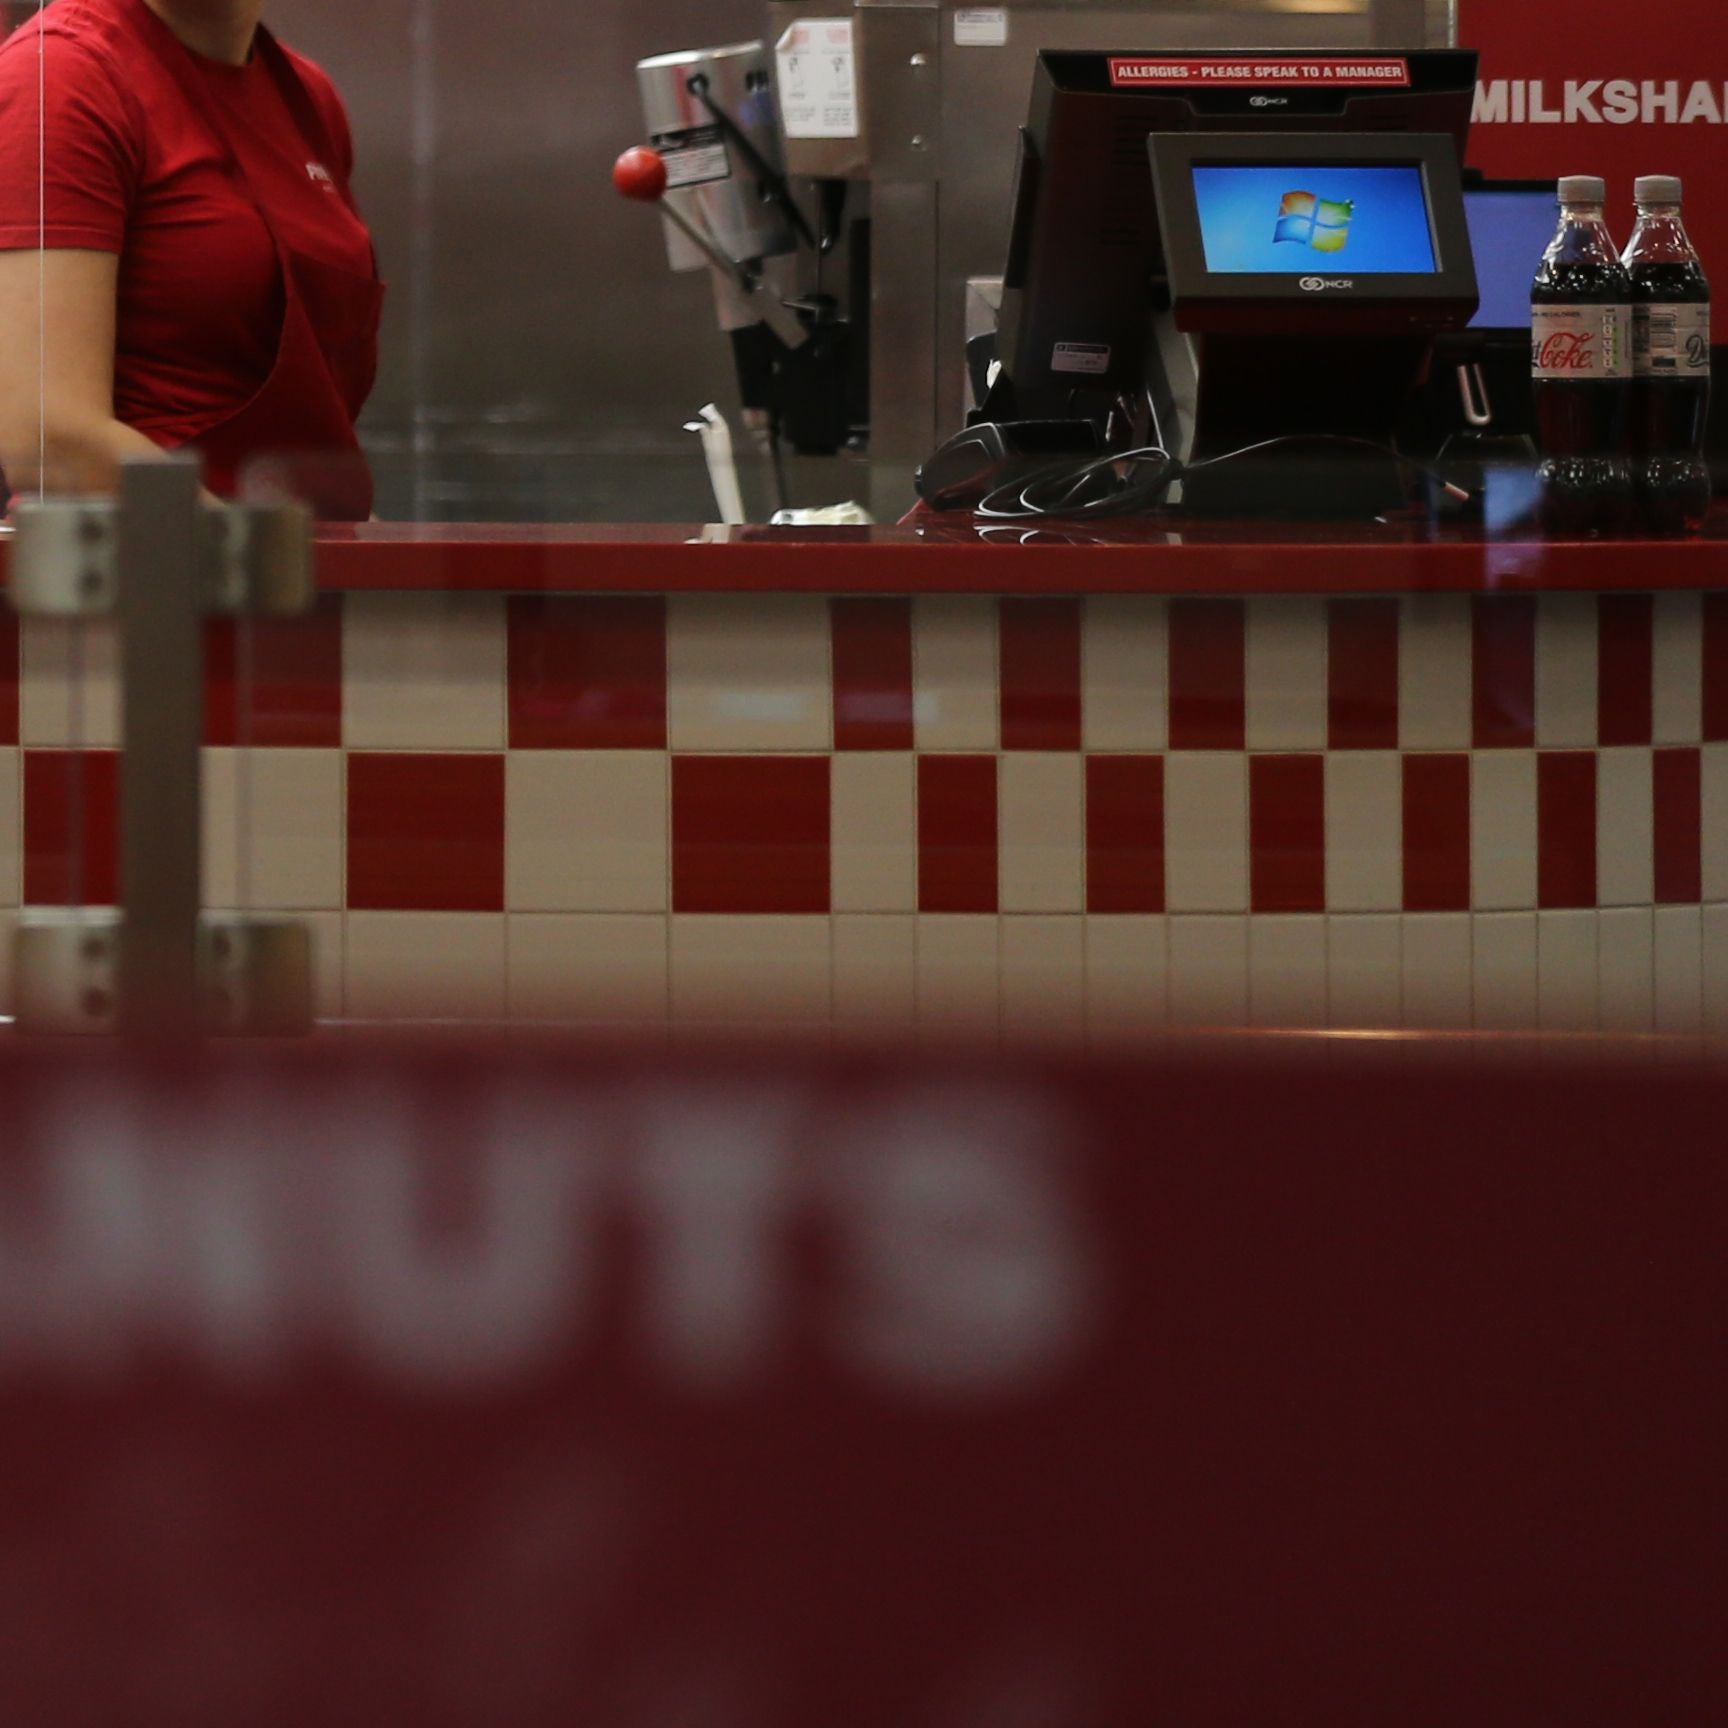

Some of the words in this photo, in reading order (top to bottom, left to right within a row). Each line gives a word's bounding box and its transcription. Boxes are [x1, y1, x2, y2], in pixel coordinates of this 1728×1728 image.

[1117, 65, 1189, 78] ALLERGIES
[1200, 66, 1252, 78] PLEASE
[1253, 66, 1299, 78] SPEAK
[1300, 66, 1320, 78] TO
[1322, 66, 1333, 78] A
[1335, 66, 1403, 78] MANAGER
[1470, 79, 1728, 125] MILKSHA
[1324, 279, 1353, 289] NCR
